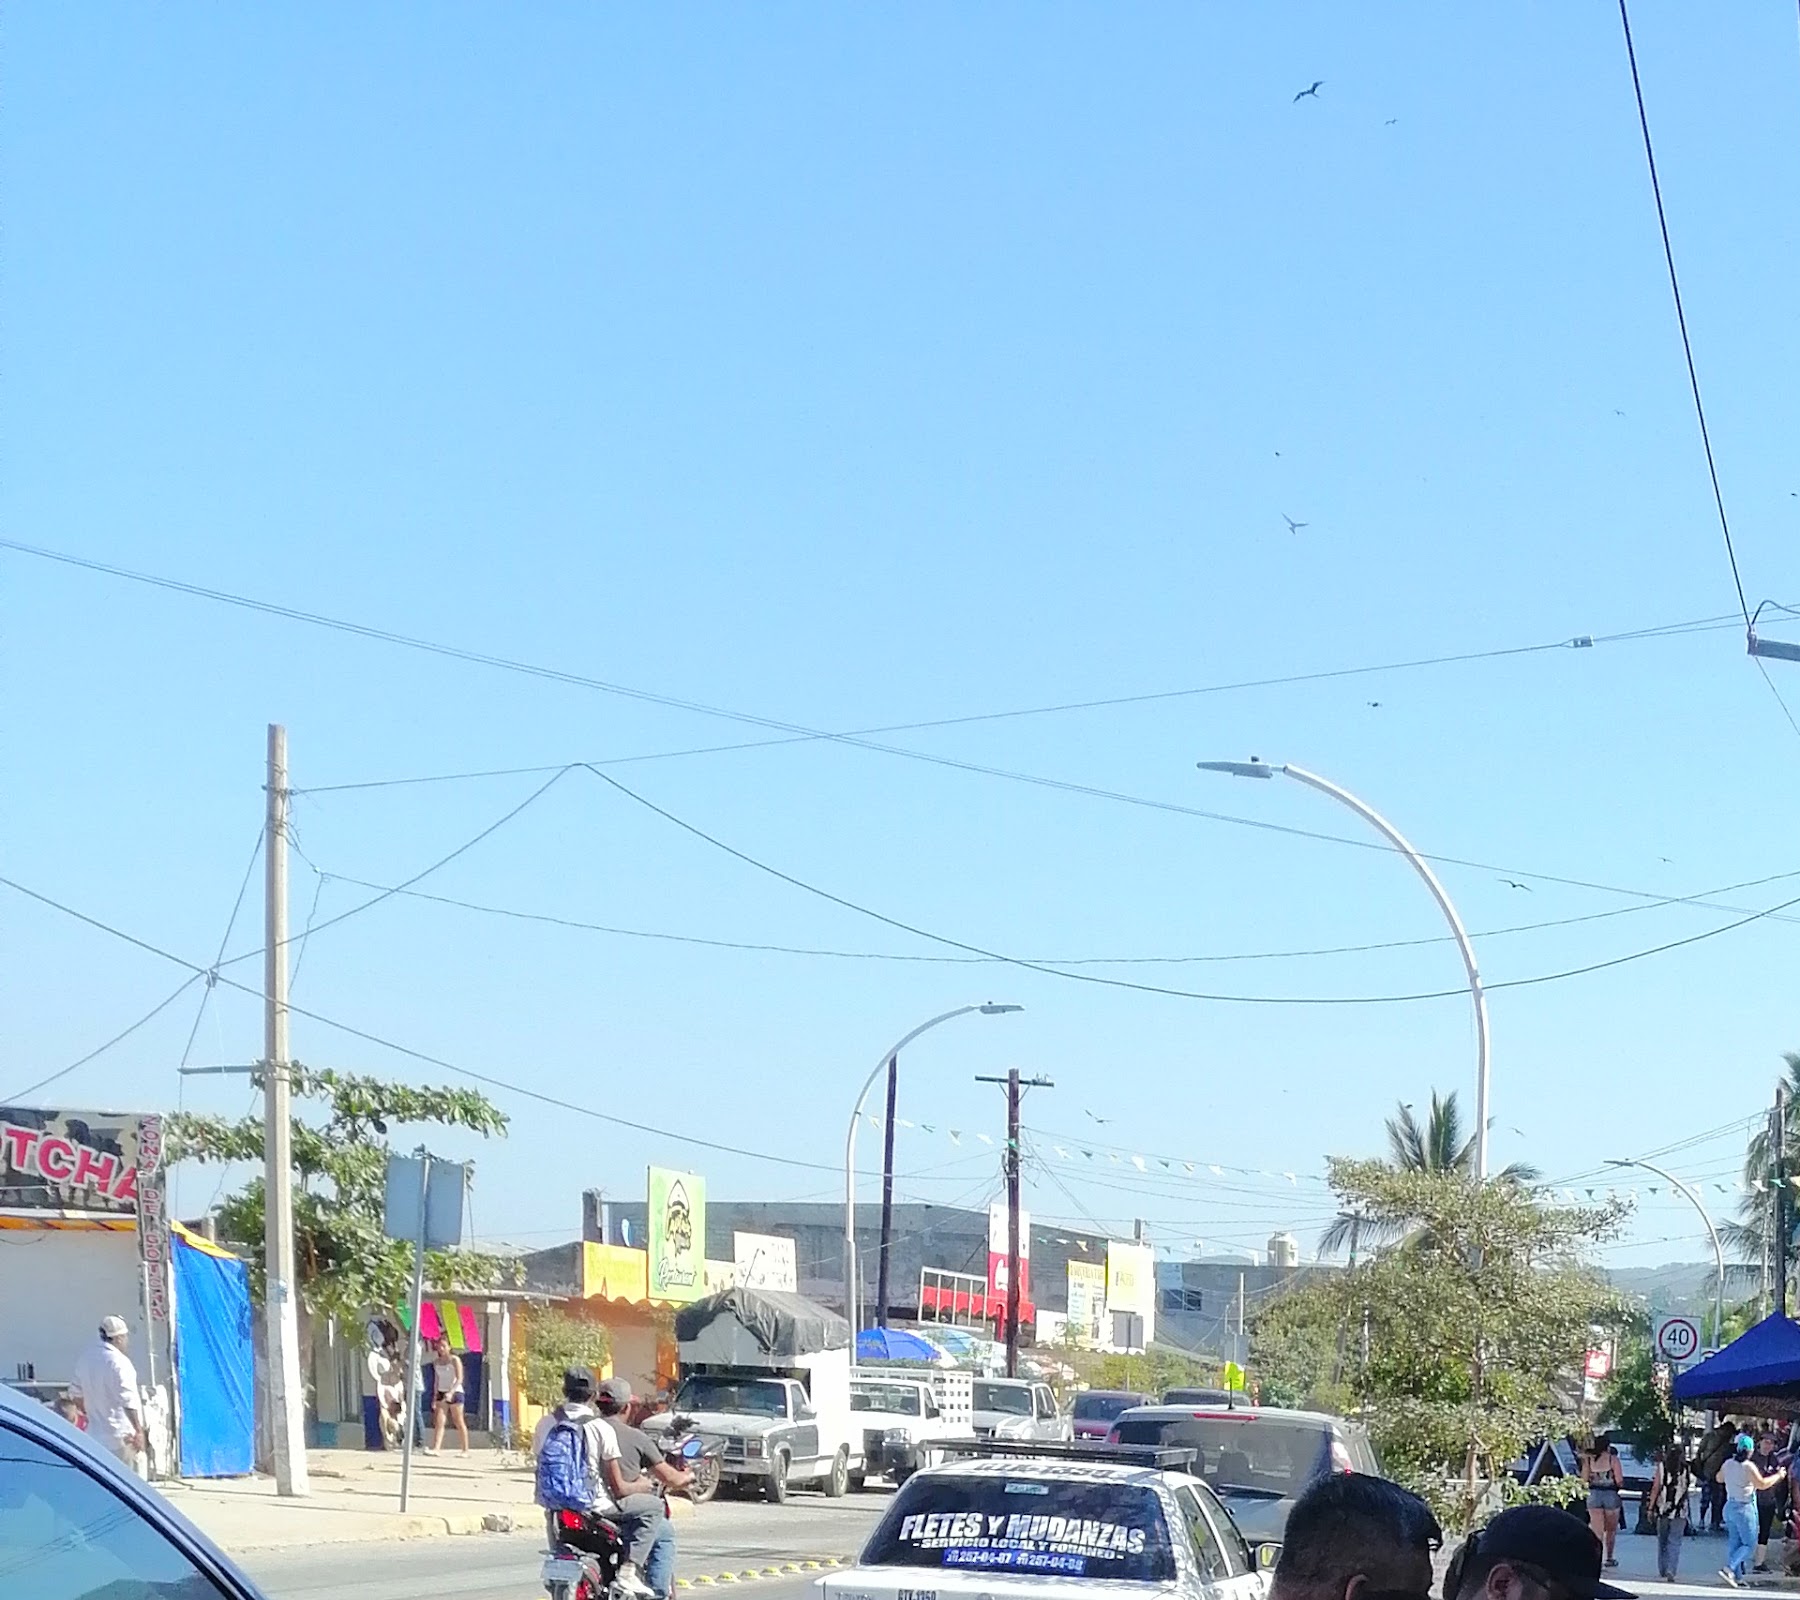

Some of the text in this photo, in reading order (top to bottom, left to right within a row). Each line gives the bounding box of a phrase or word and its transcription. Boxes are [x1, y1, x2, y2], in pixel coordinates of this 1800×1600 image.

[0, 1126, 138, 1200] TCHA
[1667, 1328, 1689, 1346] 40
[899, 1511, 1147, 1555] FLETES Y MUDANZAS
[921, 1536, 1116, 1561] SERVICIO LOCAL Y FORANEO
